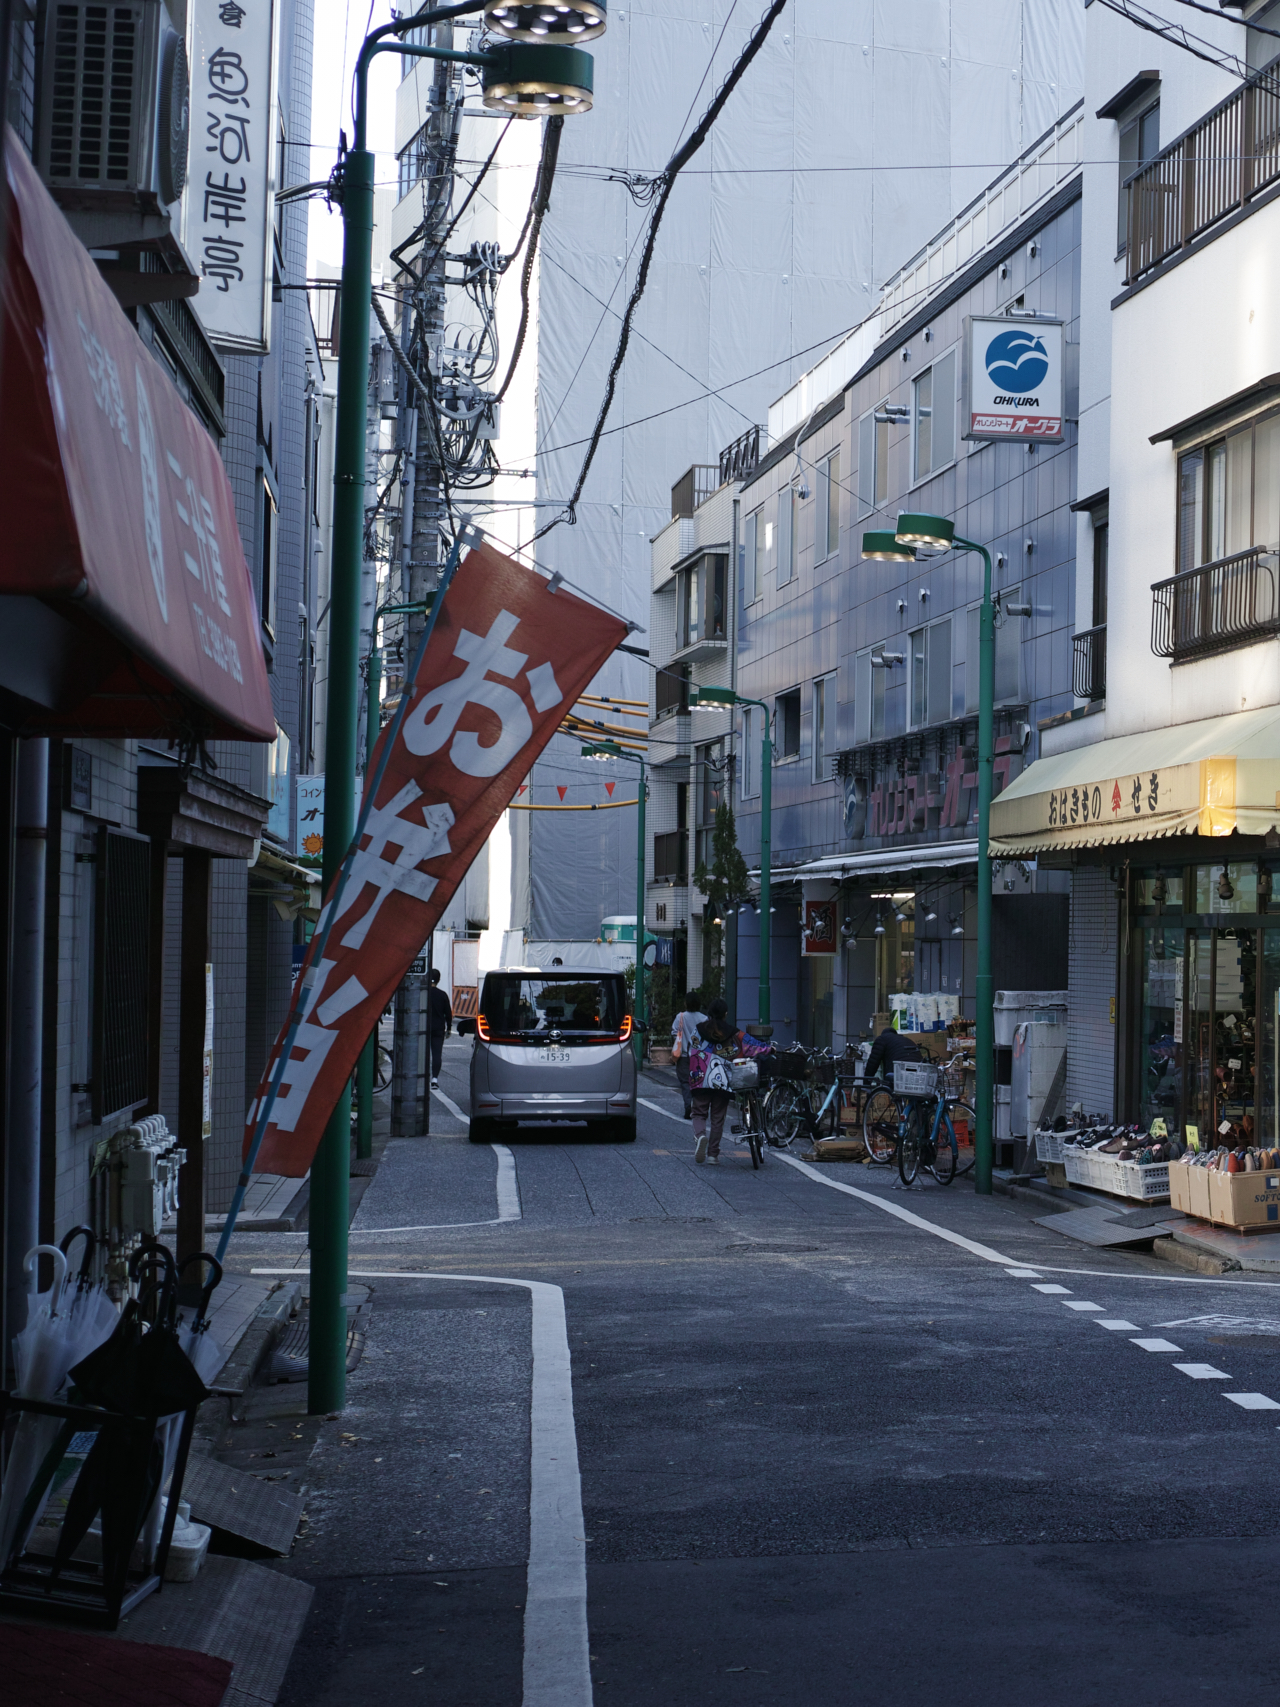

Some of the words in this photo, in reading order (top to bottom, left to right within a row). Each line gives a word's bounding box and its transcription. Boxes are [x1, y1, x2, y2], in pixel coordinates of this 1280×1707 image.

[993, 395, 1040, 409] OHKURA
[975, 417, 1012, 428] オレンジマート
[1011, 418, 1062, 434] オークラ
[1048, 785, 1102, 826] おはきもの
[1131, 772, 1159, 814] せき
[546, 1052, 570, 1061] 15-39
